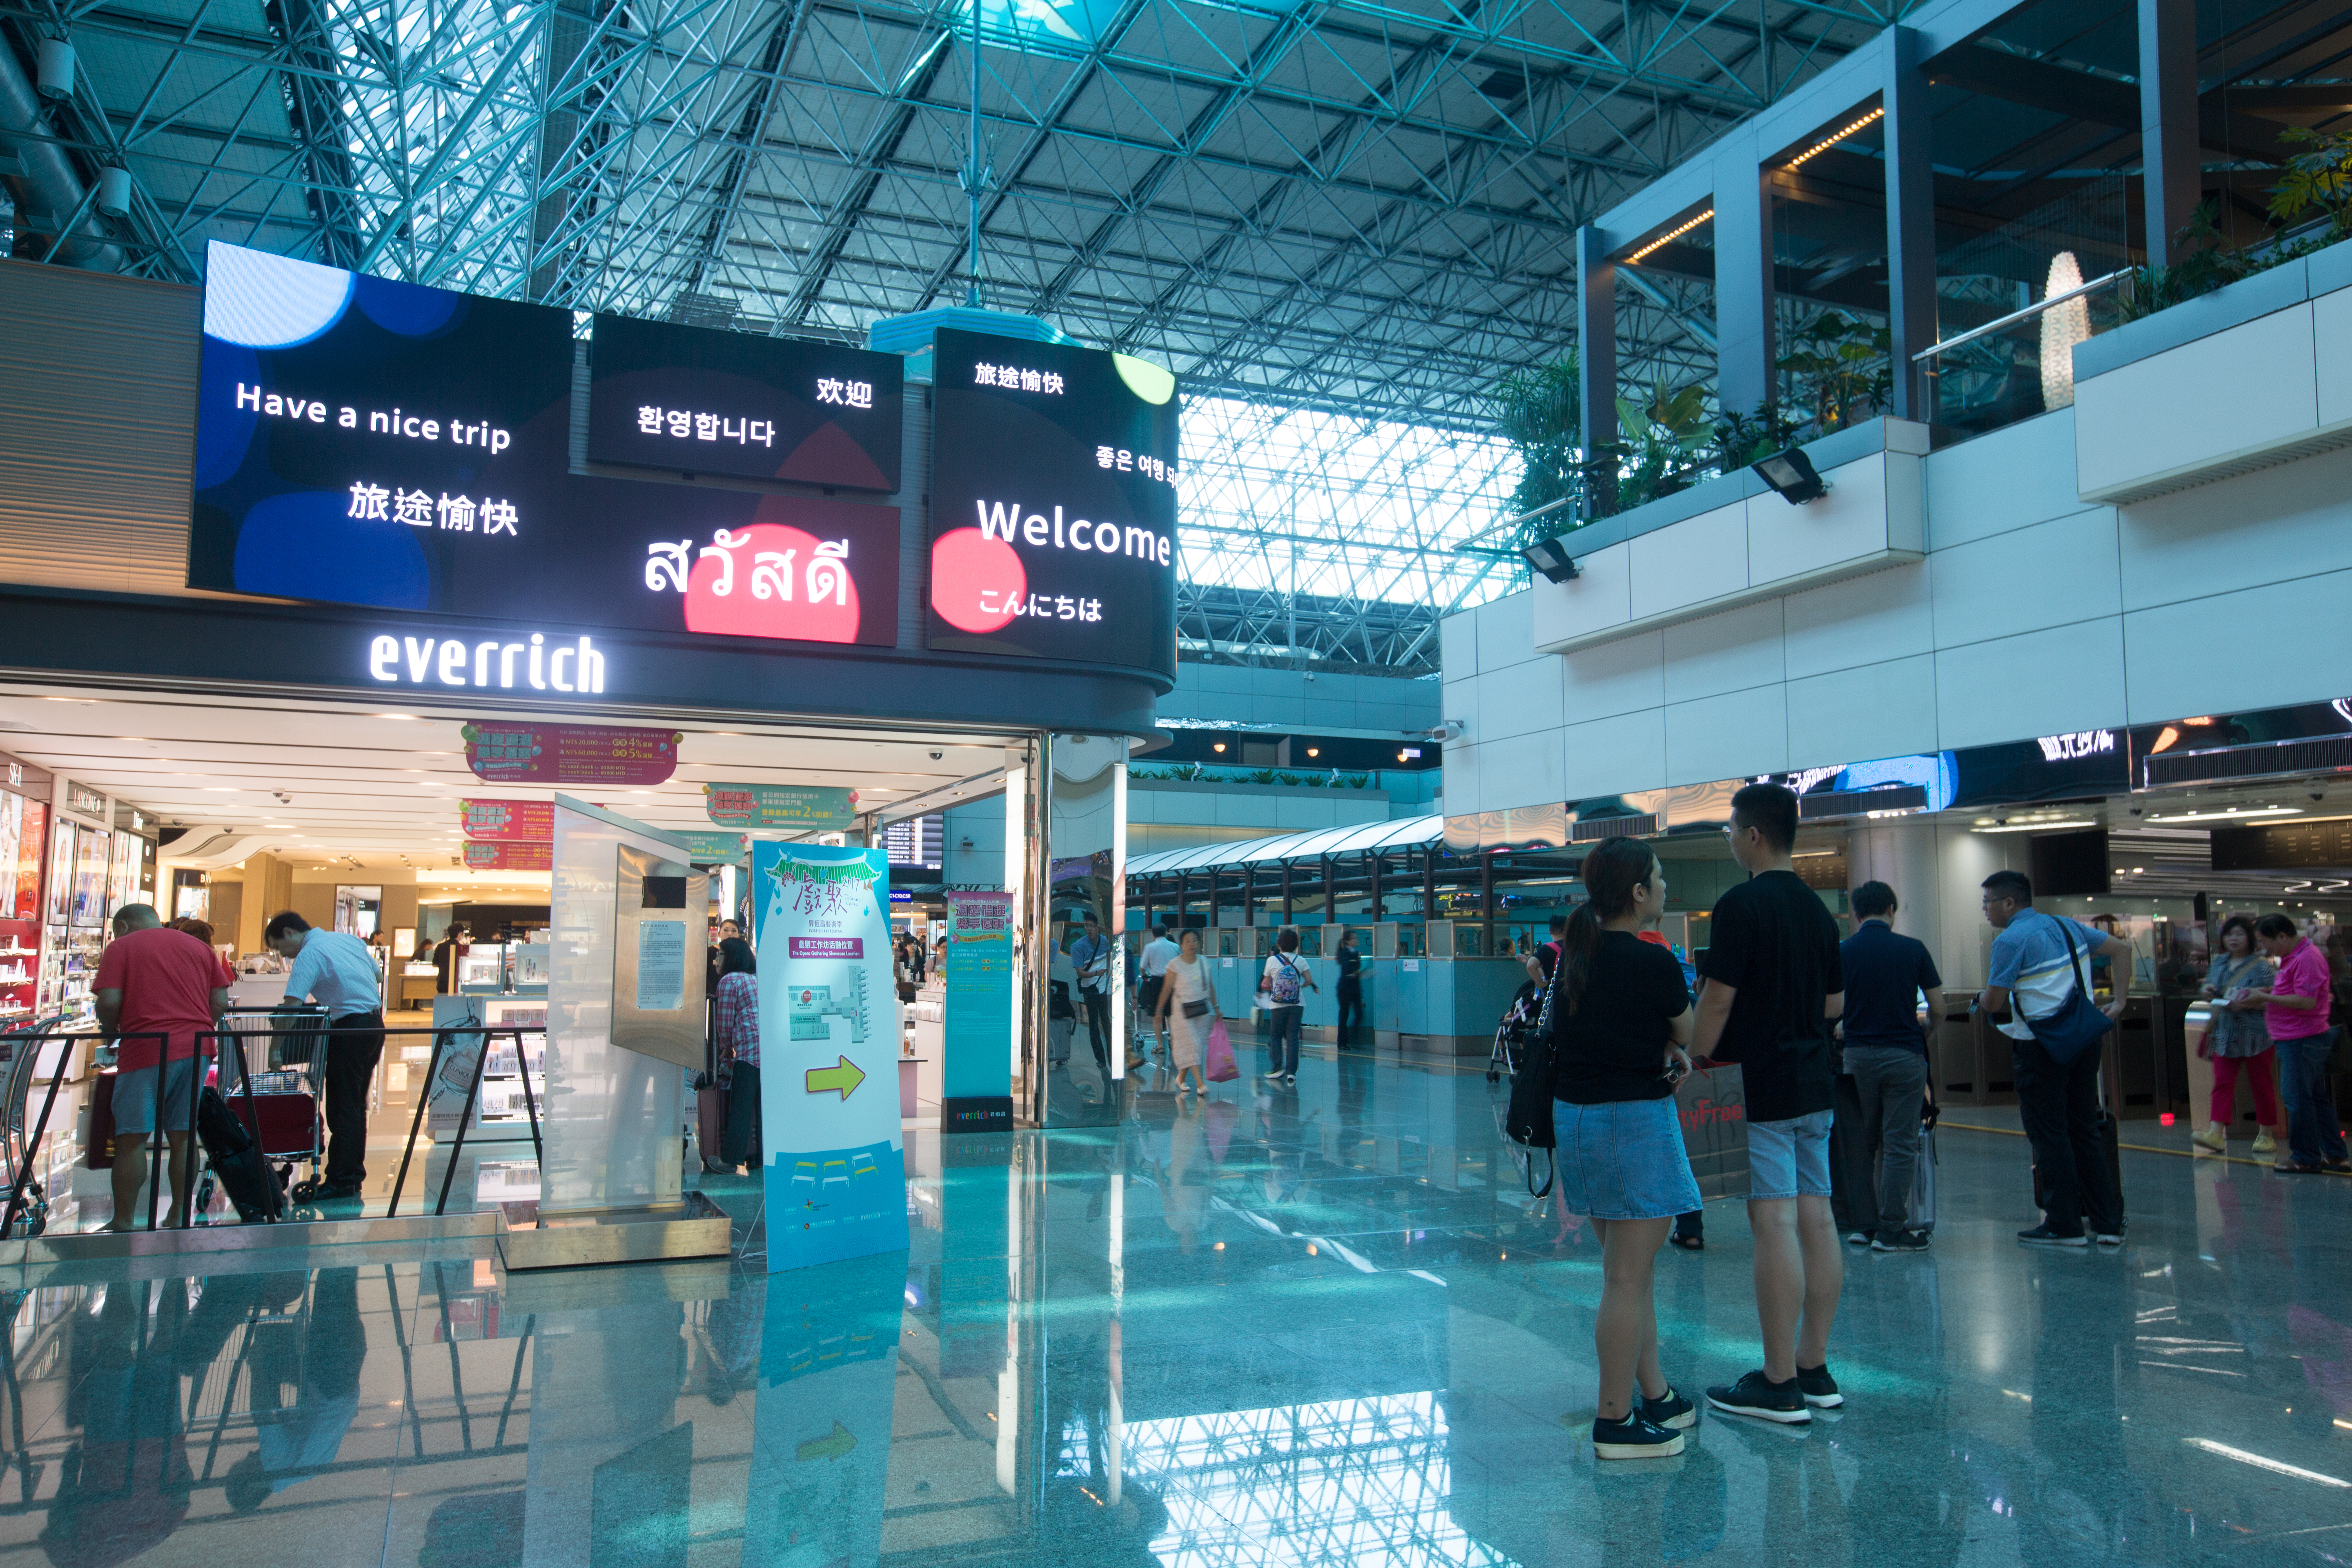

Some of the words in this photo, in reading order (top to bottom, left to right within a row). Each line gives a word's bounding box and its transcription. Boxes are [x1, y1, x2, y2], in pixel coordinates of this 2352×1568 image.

[817, 378, 871, 408] 欢迎
[975, 362, 1063, 394] 旅途愉快
[238, 383, 326, 422] Have
[339, 408, 356, 428] a
[371, 409, 439, 439] nice
[451, 420, 510, 454] trip
[638, 406, 775, 447] 환영합니다
[1096, 446, 1132, 471] 좋은
[1139, 456, 1163, 481] 여행
[348, 482, 518, 535] 旅途愉快
[977, 500, 1169, 566] Welcome
[646, 529, 848, 605] สวัสดี
[980, 590, 1101, 621] こんにちは
[370, 633, 604, 693] everrich
[74, 789, 96, 812] LANCÔME
[134, 811, 143, 831] Dior
[842, 876, 860, 893] 2017
[956, 904, 1006, 917] 週慶禮遇
[956, 918, 1004, 930] 樂享優惠
[956, 1110, 988, 1120] everrich
[1678, 1099, 1743, 1132] tyFree
